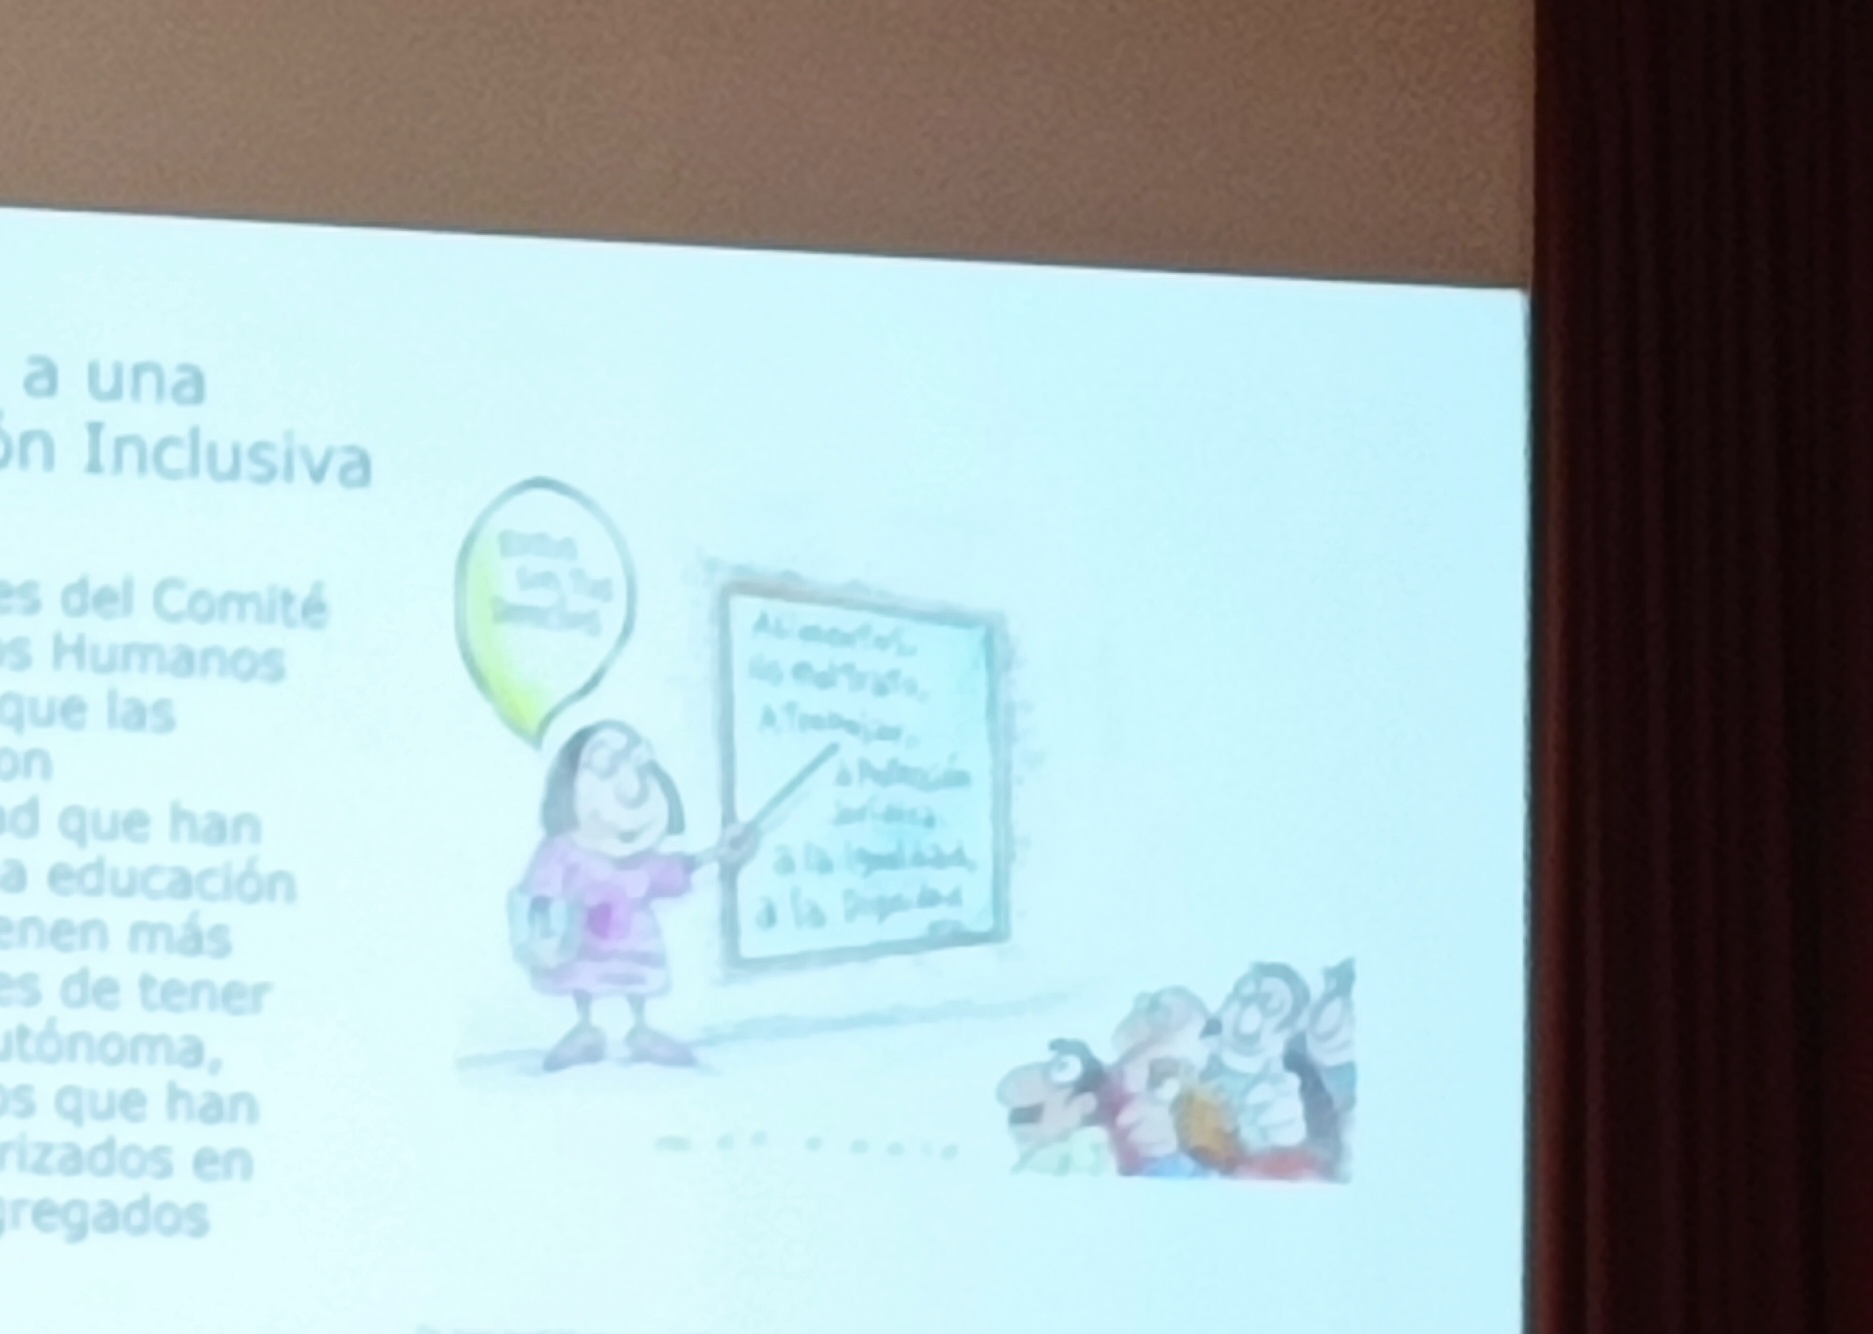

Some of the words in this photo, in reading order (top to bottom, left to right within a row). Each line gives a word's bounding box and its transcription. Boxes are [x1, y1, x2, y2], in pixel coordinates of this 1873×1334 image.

[22, 353, 60, 398] a
[86, 358, 207, 406] una
[84, 420, 373, 489] Inclusiva
[59, 574, 134, 621] del
[152, 575, 329, 630] Comité
[52, 629, 287, 684] Humanos
[107, 687, 177, 735] las
[57, 803, 151, 849] que
[168, 799, 263, 847] han
[46, 853, 297, 906] educación
[127, 909, 233, 960] más
[59, 966, 121, 1011] de
[139, 970, 274, 1017] tener
[53, 1082, 147, 1128] que
[165, 1079, 260, 1127] han
[191, 1144, 254, 1183] en
